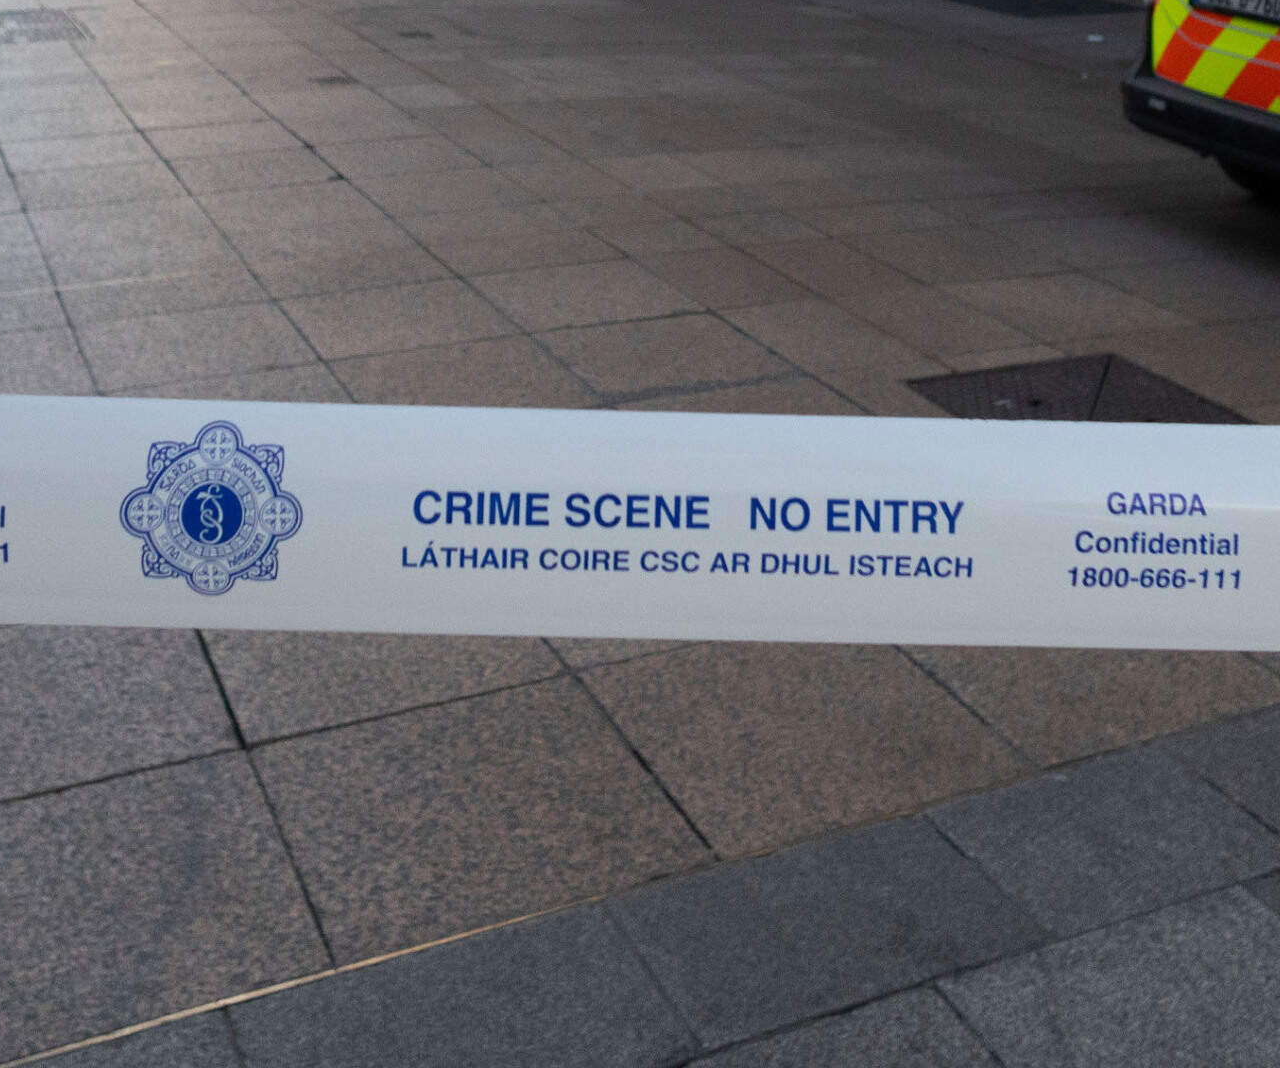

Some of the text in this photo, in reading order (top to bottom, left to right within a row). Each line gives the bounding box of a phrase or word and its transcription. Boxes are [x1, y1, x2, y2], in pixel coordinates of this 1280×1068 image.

[413, 489, 964, 535] CRIME SCENE NO ENTRY
[1107, 491, 1207, 517] GARDA
[1075, 530, 1239, 556] Confidential
[401, 540, 973, 578] LÁTHAIR COIRE CSC AR DHUL ISTEACH
[1068, 566, 1241, 590] 1800-666-111
